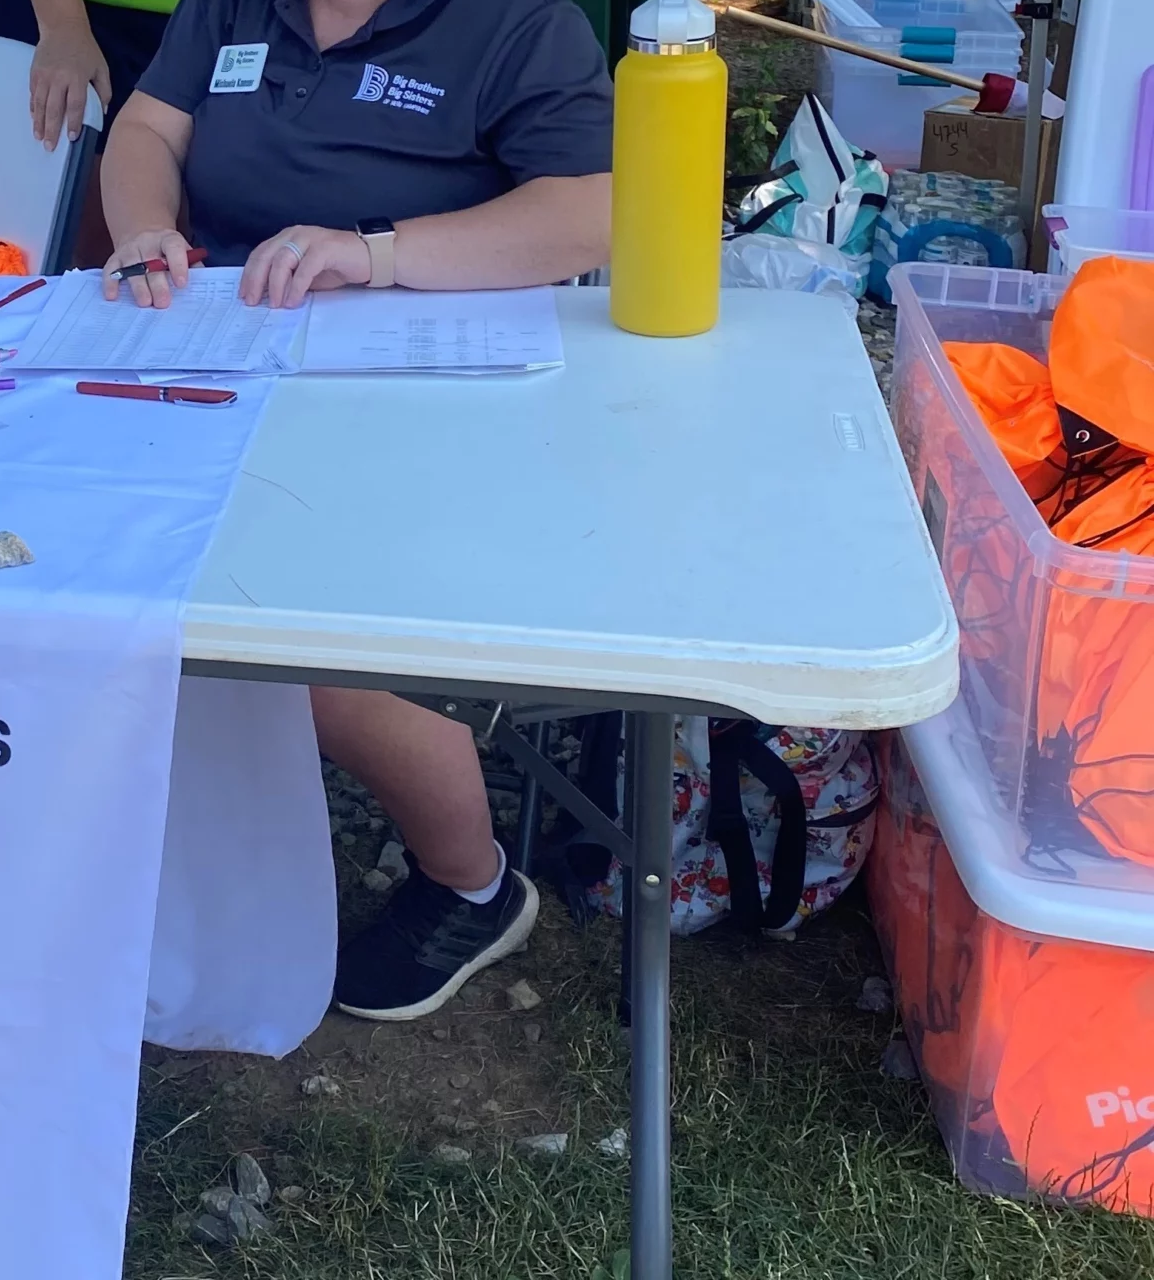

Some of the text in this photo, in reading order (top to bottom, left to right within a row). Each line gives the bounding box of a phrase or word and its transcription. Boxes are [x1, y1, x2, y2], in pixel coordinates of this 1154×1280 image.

[387, 86, 403, 100] Big
[392, 74, 446, 97] Big Brothers
[932, 121, 969, 143] 4744
